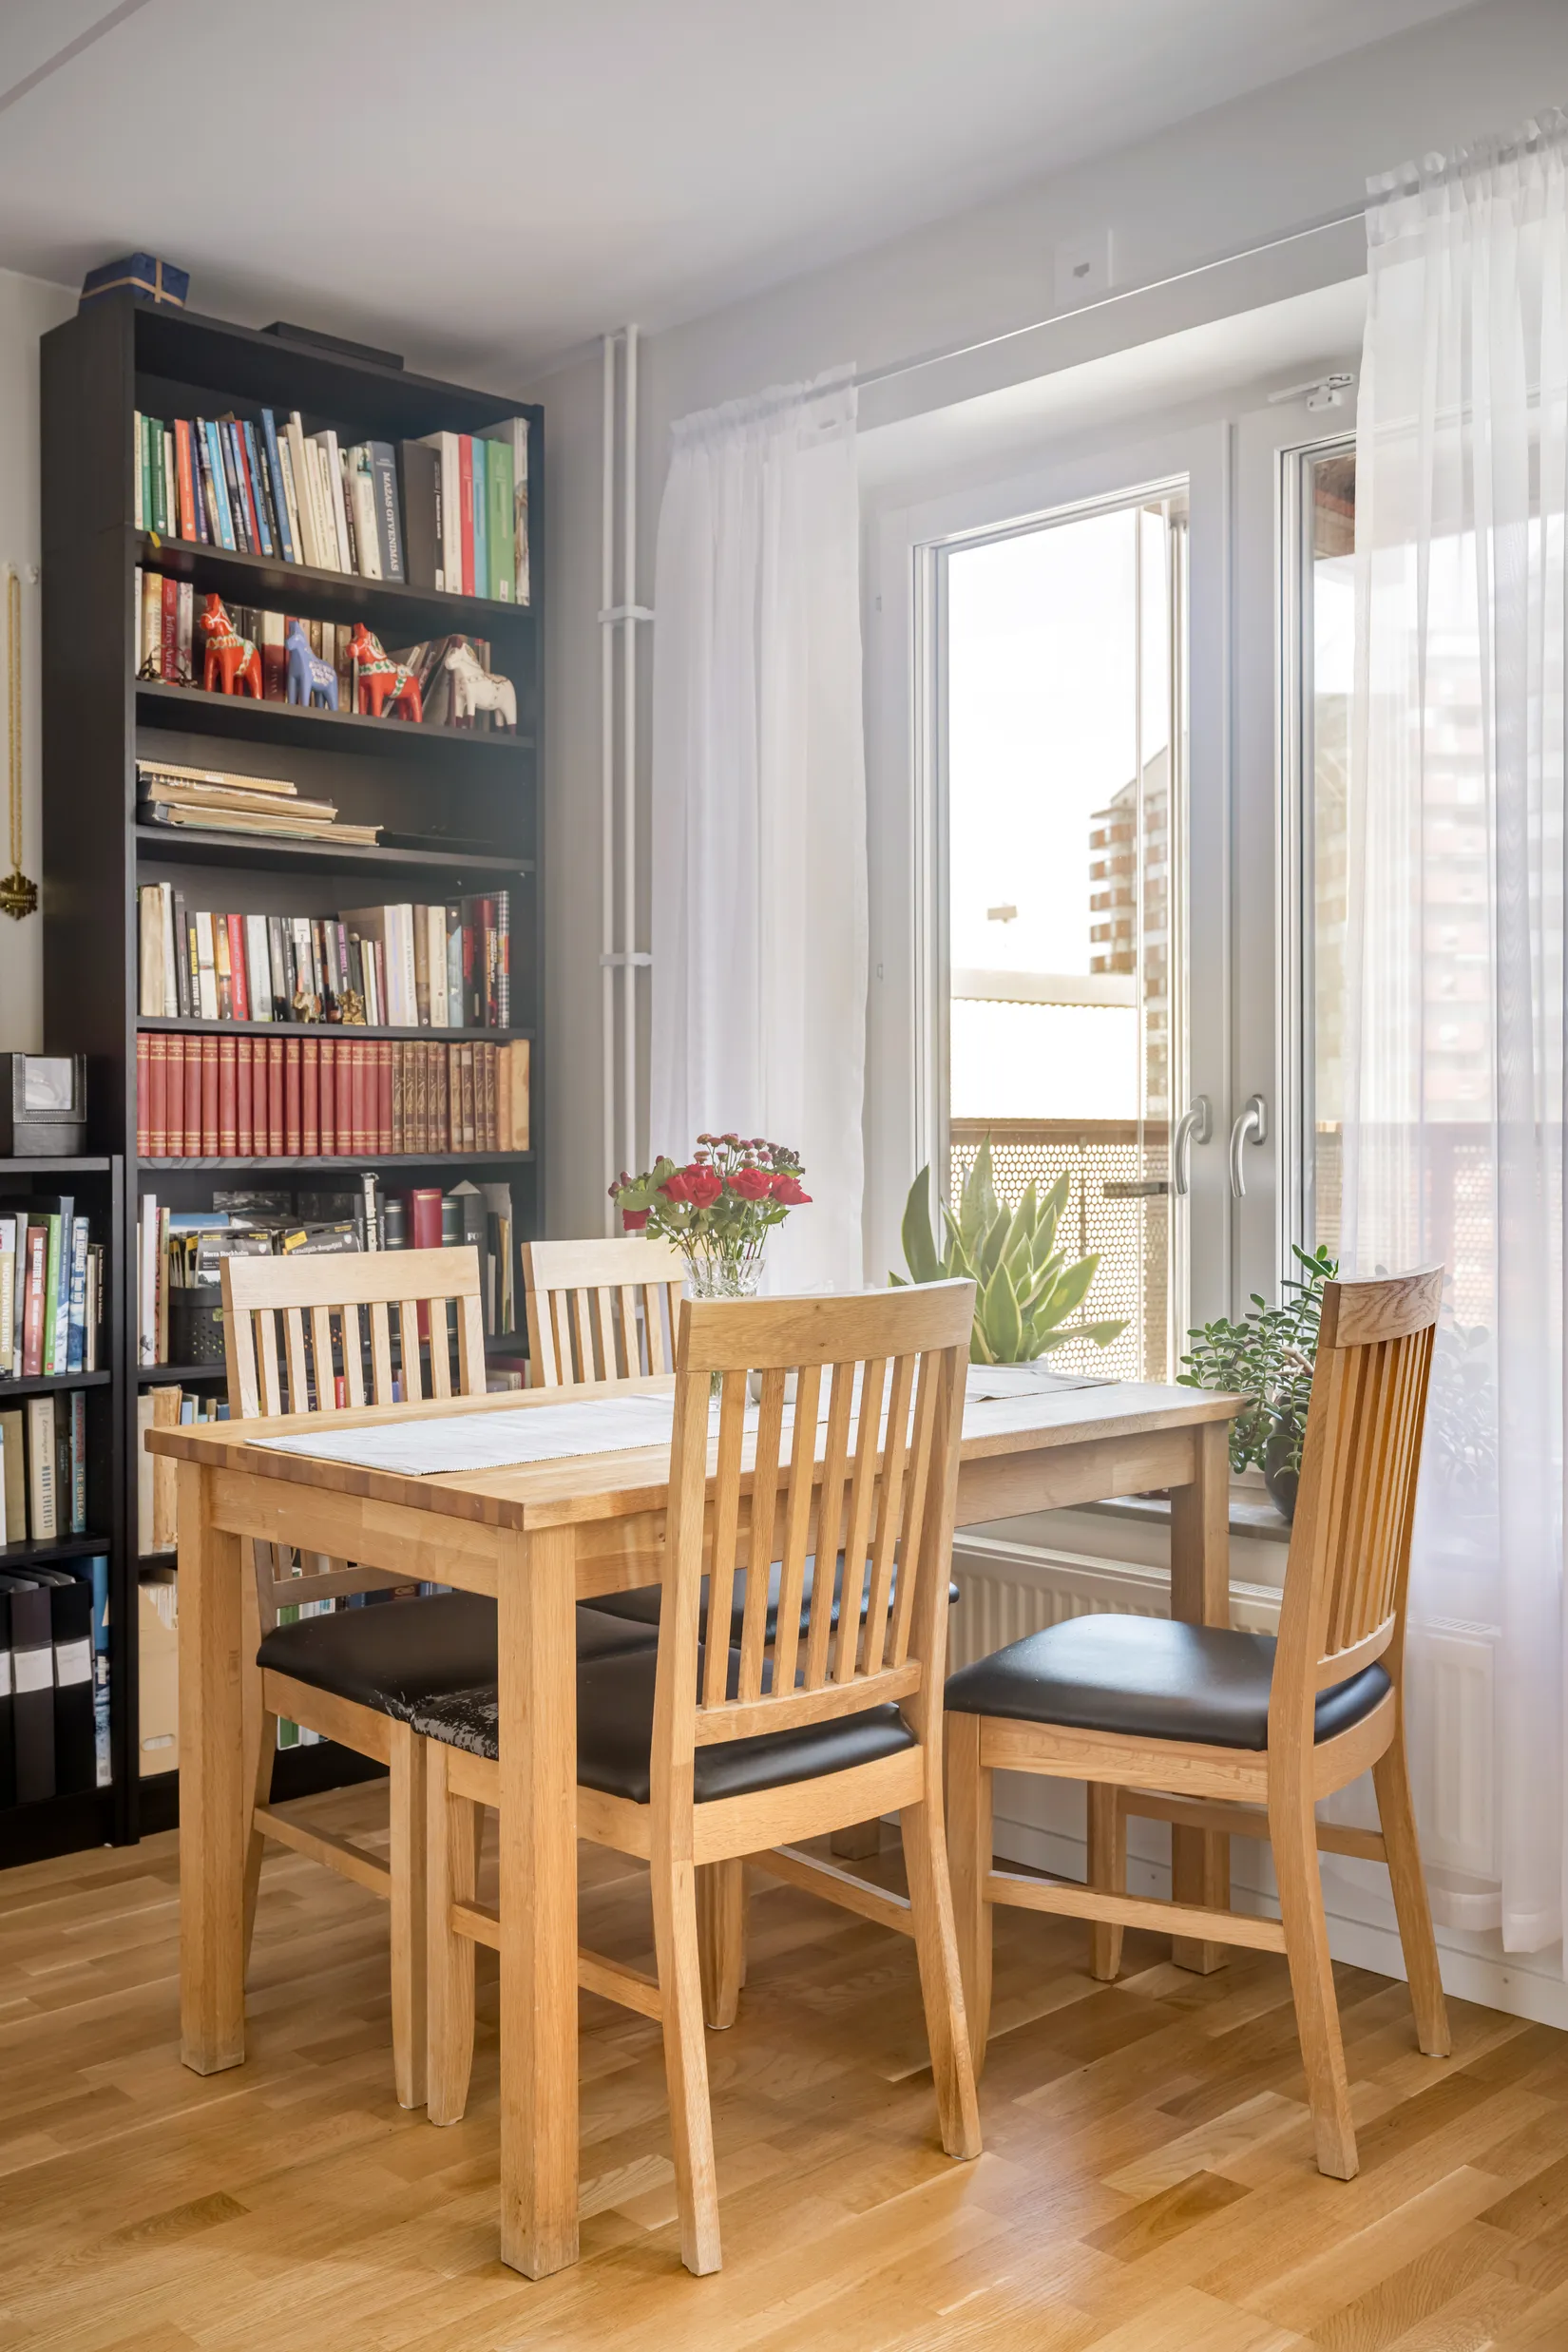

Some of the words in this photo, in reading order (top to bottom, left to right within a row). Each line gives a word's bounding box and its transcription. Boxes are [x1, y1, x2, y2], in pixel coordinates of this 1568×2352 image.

[383, 471, 393, 507] MAŽAS
[386, 508, 399, 572] GYVENIMAS
[164, 612, 175, 645] Jeffrey
[1, 1262, 10, 1353] MOUNTAINEERING
[42, 1465, 51, 1492] MOUNT
[43, 1494, 53, 1528] EVEREST
